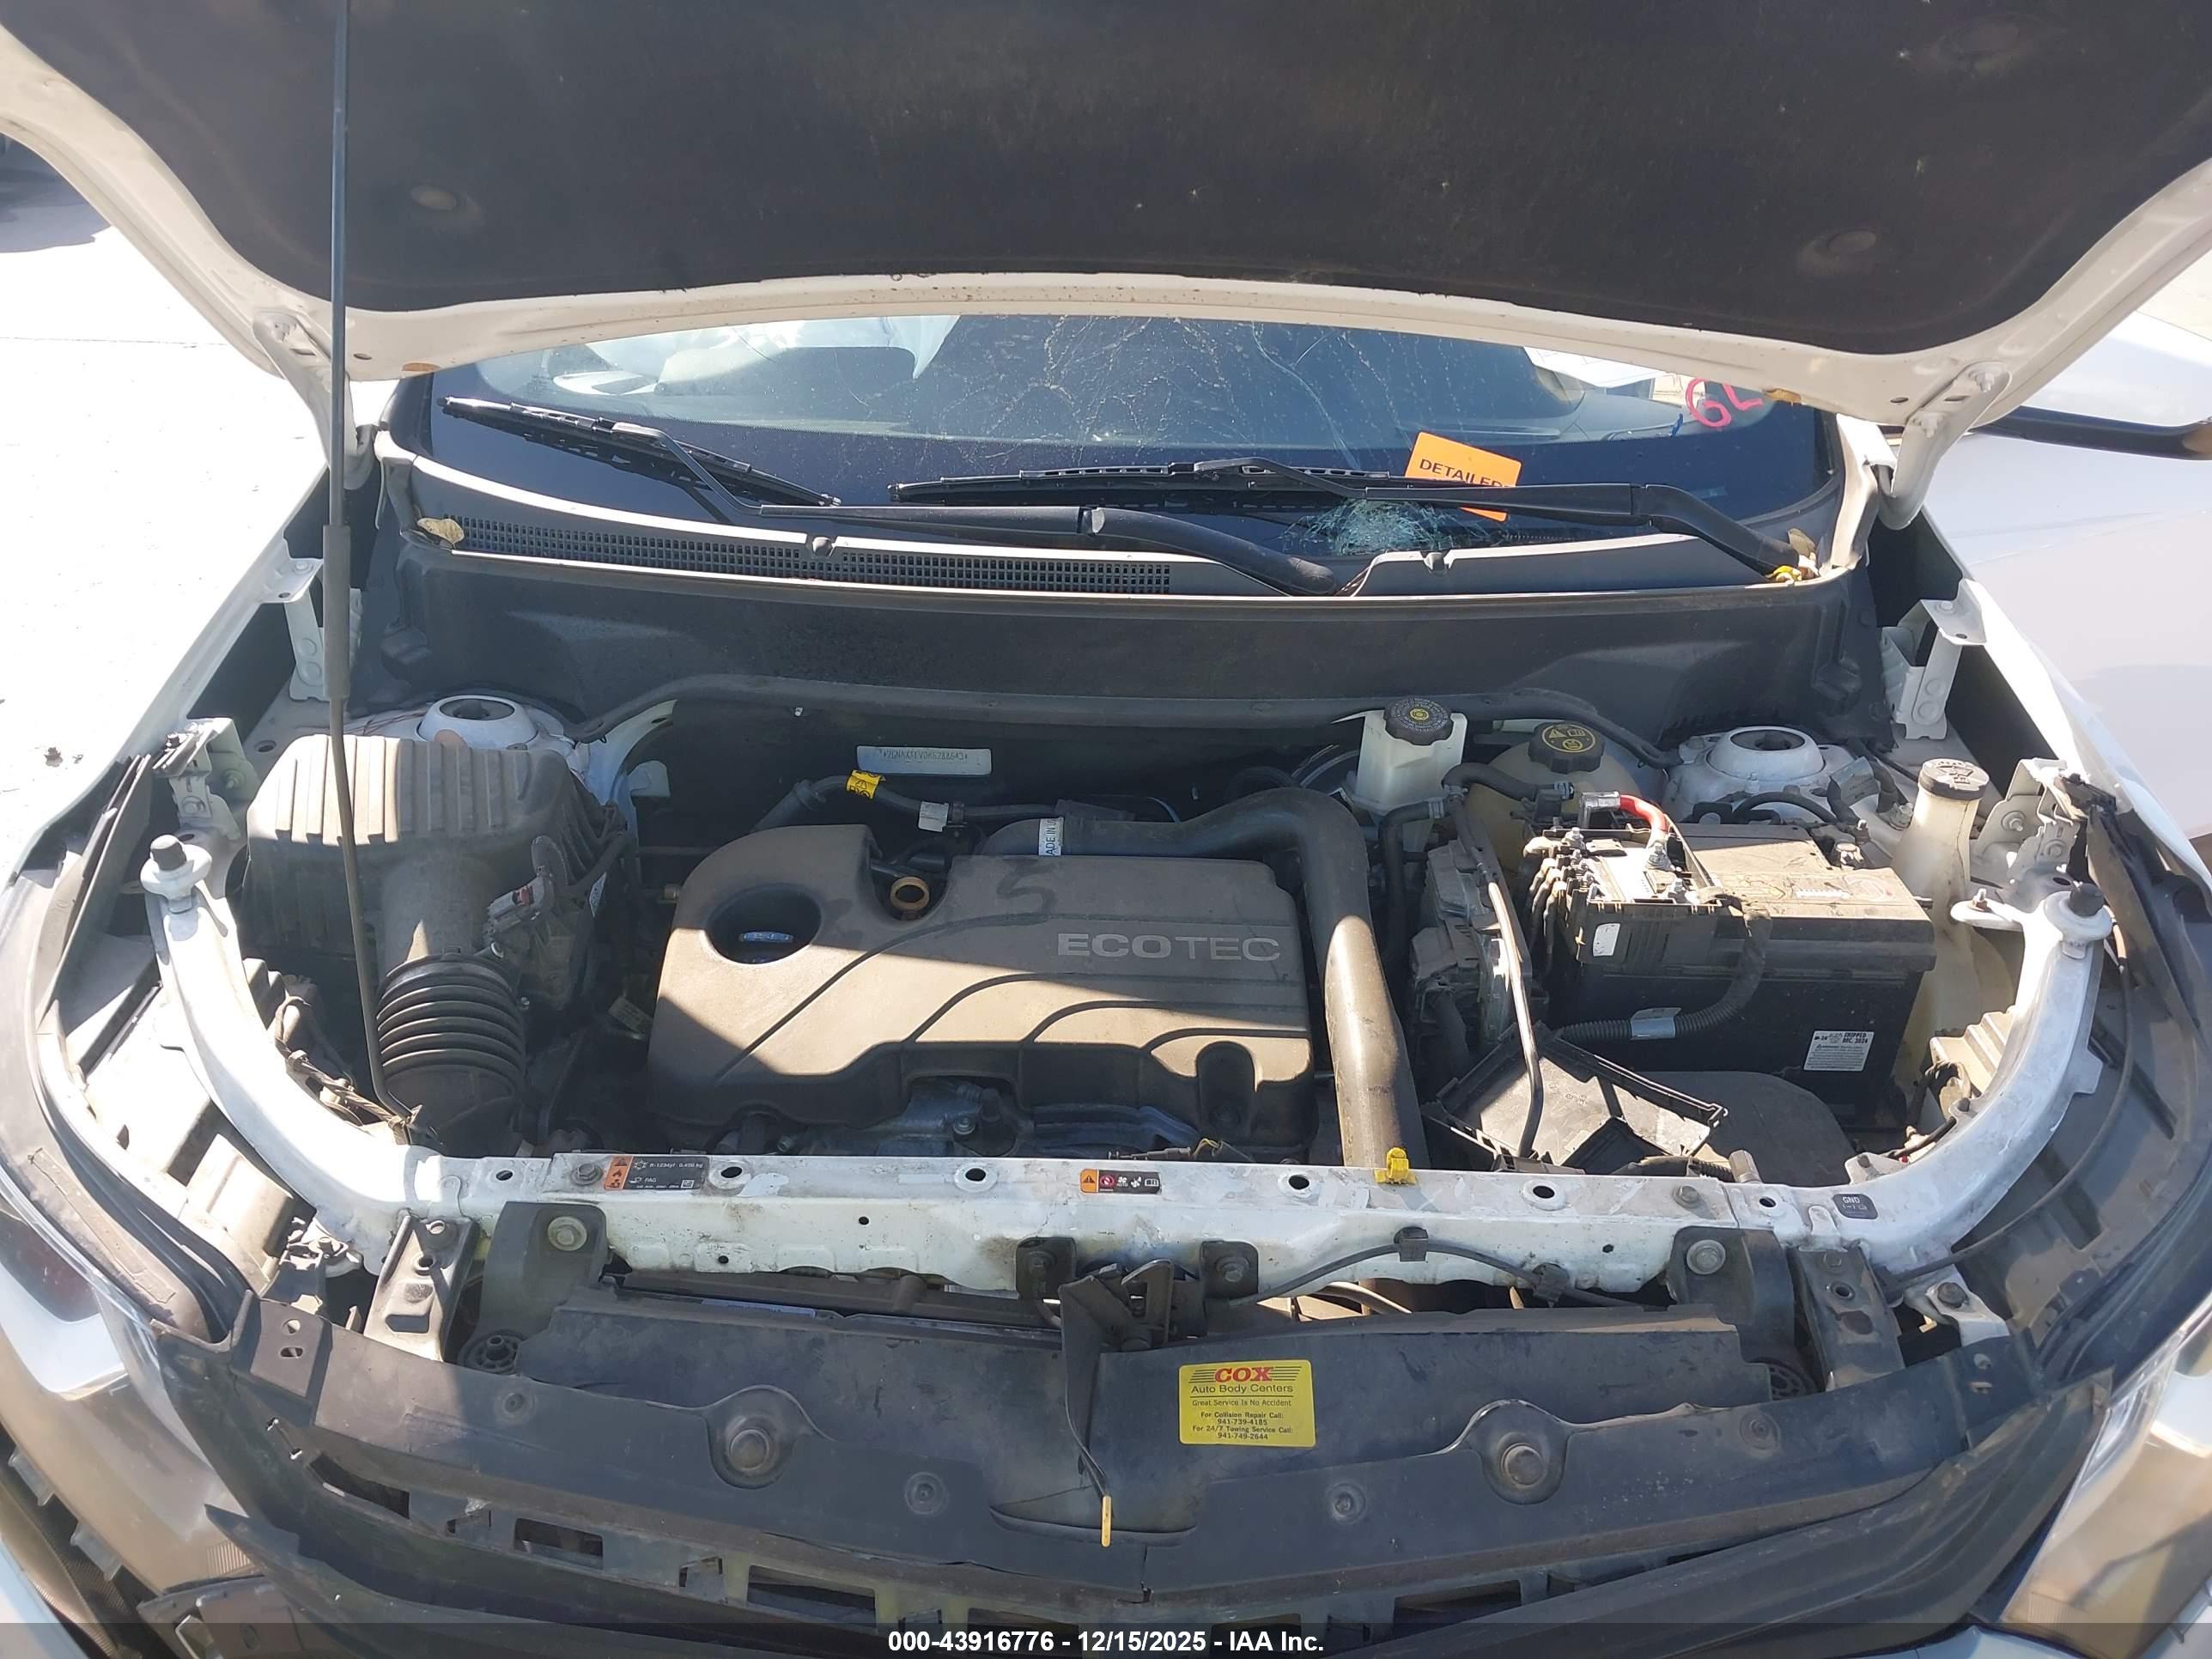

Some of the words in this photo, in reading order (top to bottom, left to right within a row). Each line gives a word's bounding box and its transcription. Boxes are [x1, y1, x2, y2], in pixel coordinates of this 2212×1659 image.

[1057, 933, 1281, 962] ECOTEC
[1214, 1366, 1273, 1383] COX
[1191, 1385, 1216, 1394] Auto
[1218, 1384, 1248, 1395] Body
[1250, 1383, 1293, 1393] Centers
